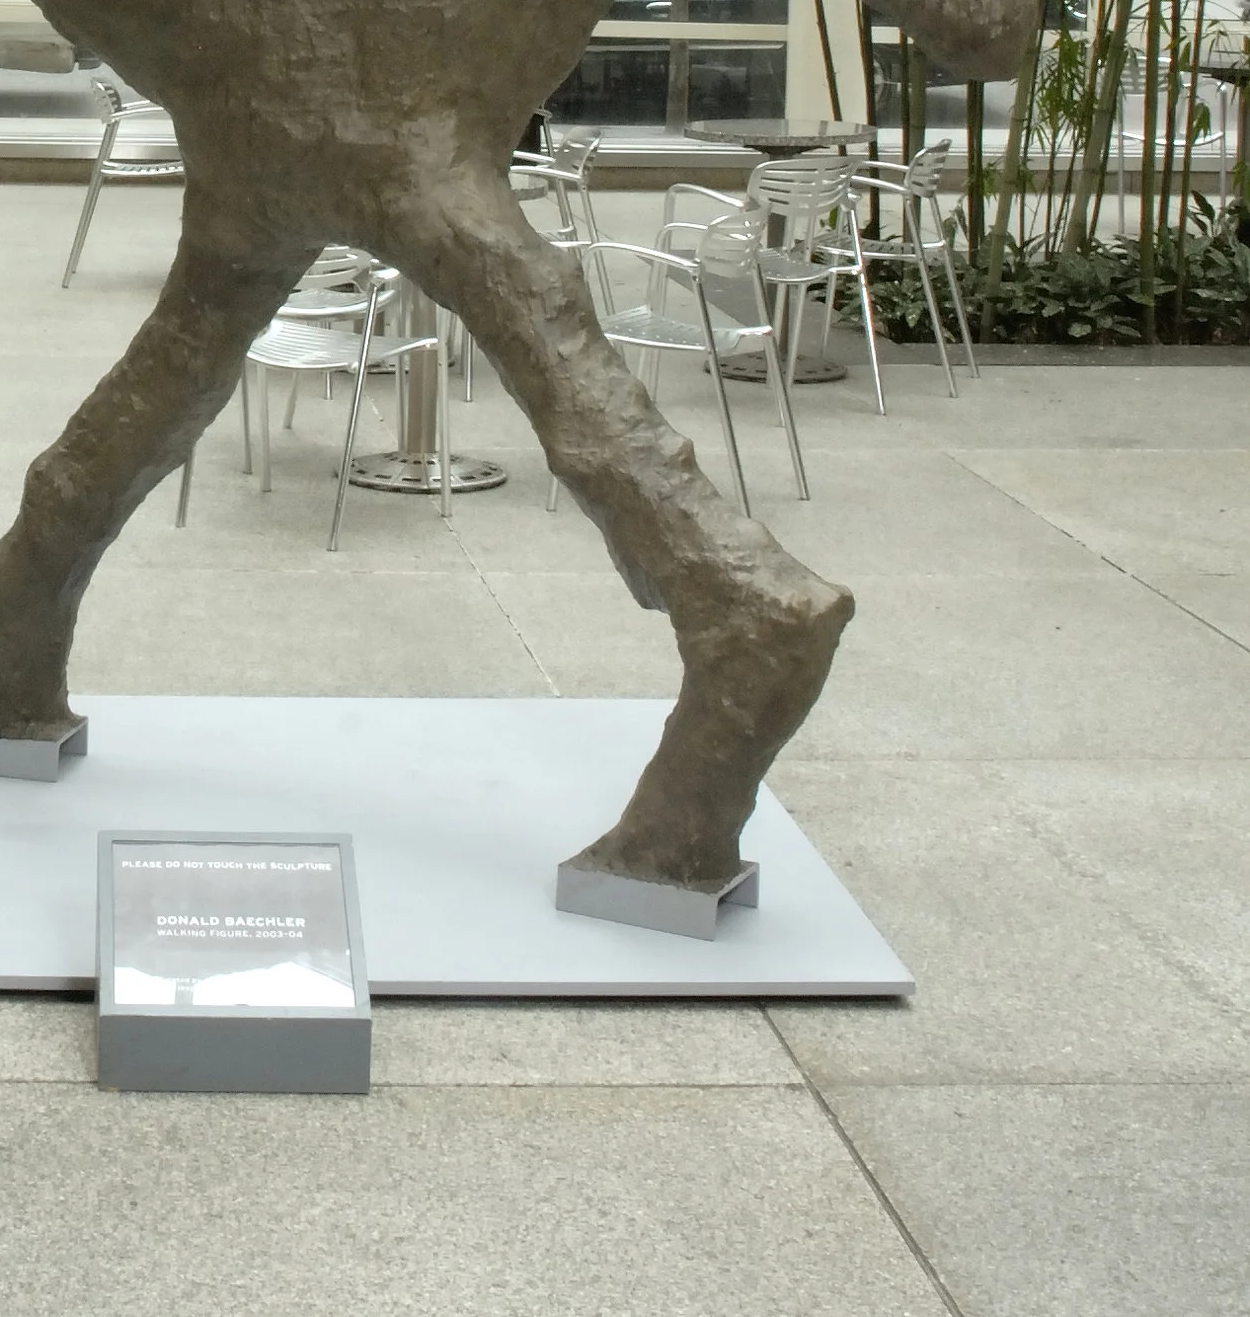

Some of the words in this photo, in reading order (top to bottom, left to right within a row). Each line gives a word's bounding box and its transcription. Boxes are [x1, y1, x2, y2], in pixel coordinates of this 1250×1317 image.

[121, 860, 163, 869] PLEASE
[165, 860, 181, 868] DO
[183, 861, 204, 869] NOT
[207, 861, 243, 870] TOUCH
[246, 862, 267, 870] THE
[270, 862, 332, 871] SCULPTURE
[156, 915, 220, 926] DONALD
[224, 916, 306, 928] BAECHLER
[156, 929, 207, 938] WALKING
